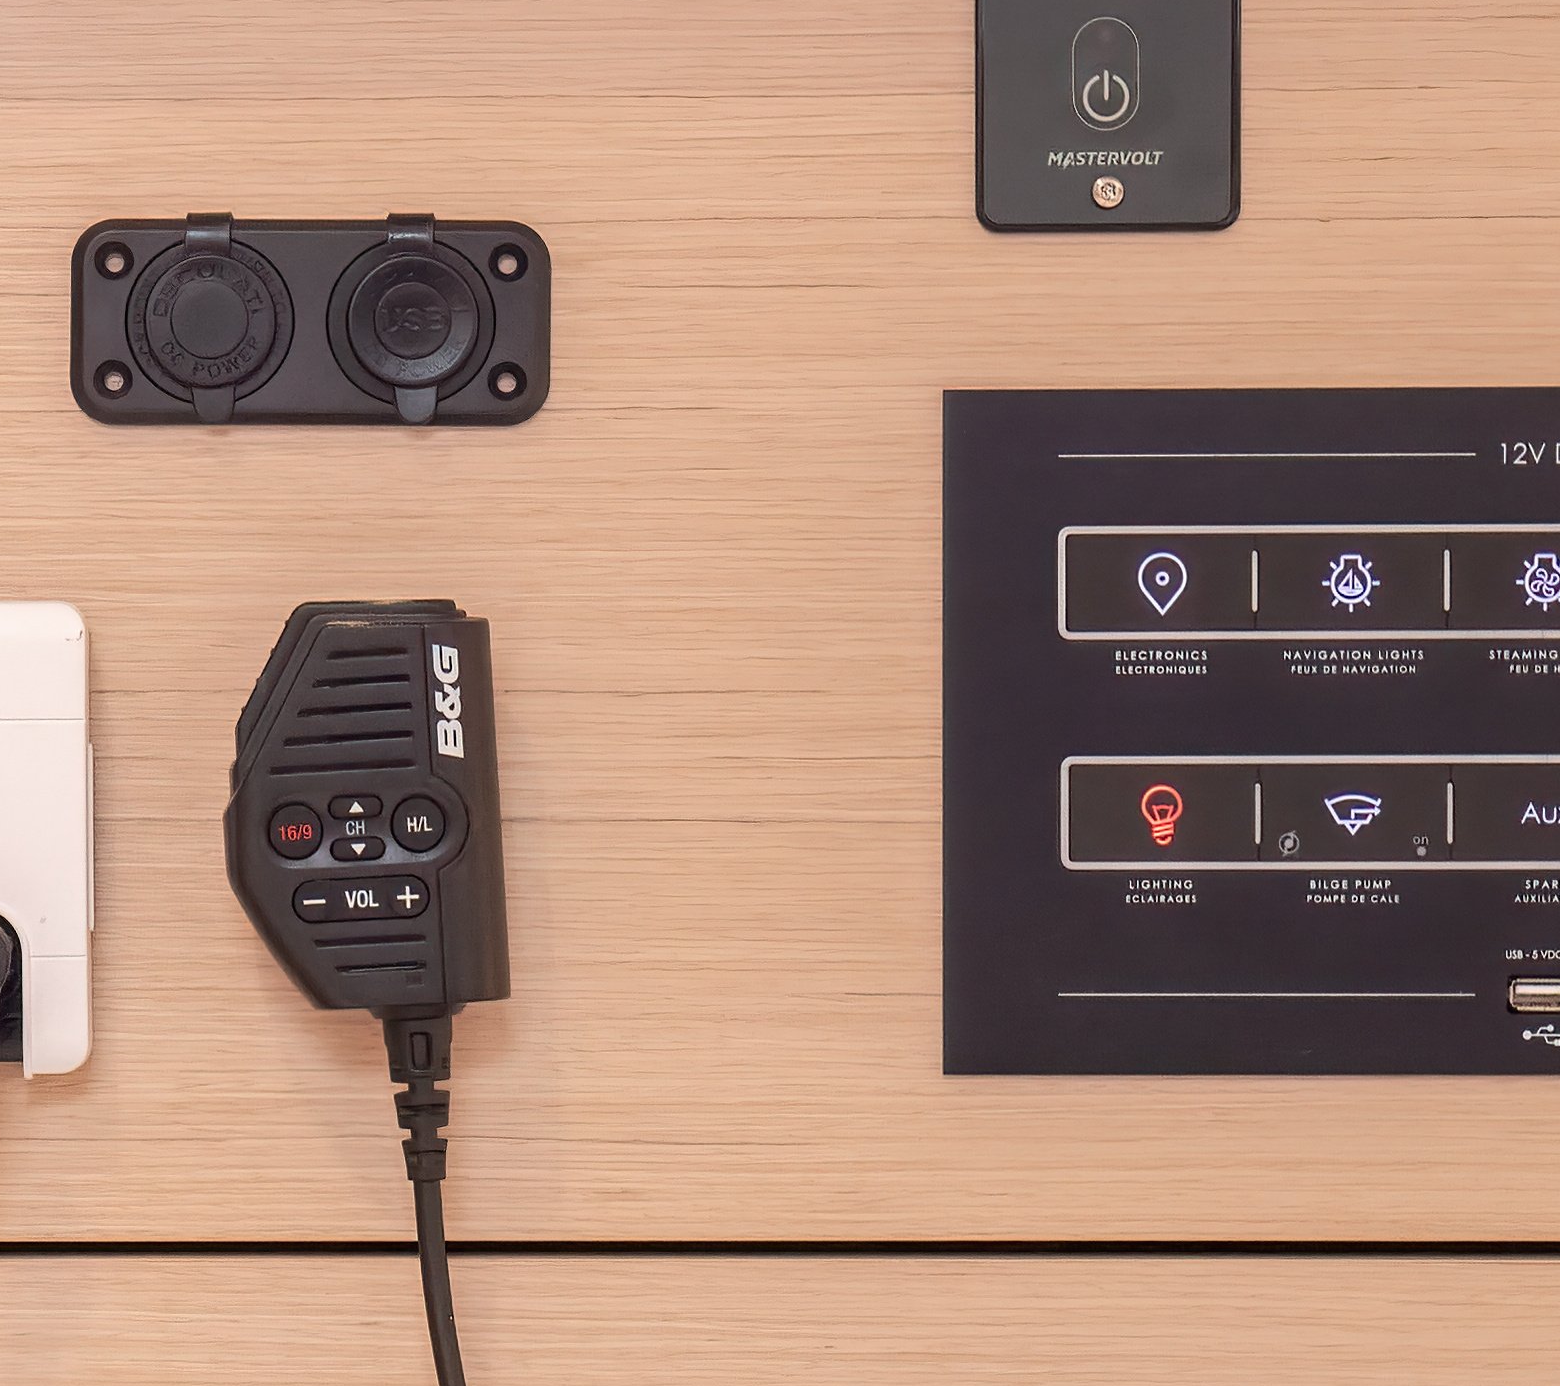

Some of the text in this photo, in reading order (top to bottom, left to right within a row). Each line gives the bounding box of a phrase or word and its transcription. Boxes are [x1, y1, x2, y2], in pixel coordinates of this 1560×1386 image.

[1048, 151, 1163, 169] MASTERVOLT
[1501, 443, 1545, 464] 12V
[1116, 651, 1207, 660] ELECTRONICS
[1284, 650, 1423, 660] NAVIGATION LIGHTS
[1490, 650, 1558, 660] STEAMING
[1116, 666, 1206, 674] ELECTRONIQUES
[1291, 665, 1415, 674] FEUX DE NAVIGATION
[1510, 665, 1528, 673] FEU
[1535, 665, 1548, 673] DE
[432, 644, 464, 758] B&G
[346, 821, 365, 835] CH
[407, 816, 432, 832] H/L
[279, 824, 311, 840] 16/9
[1413, 836, 1428, 845] on
[1130, 880, 1192, 889] LIGHTING
[1310, 880, 1391, 889] BILGE PUMP
[345, 890, 379, 908] VOL
[1126, 895, 1196, 903] ECLAIRAGES
[1307, 895, 1399, 903] POMPE DE CALE
[1506, 950, 1523, 959] USB
